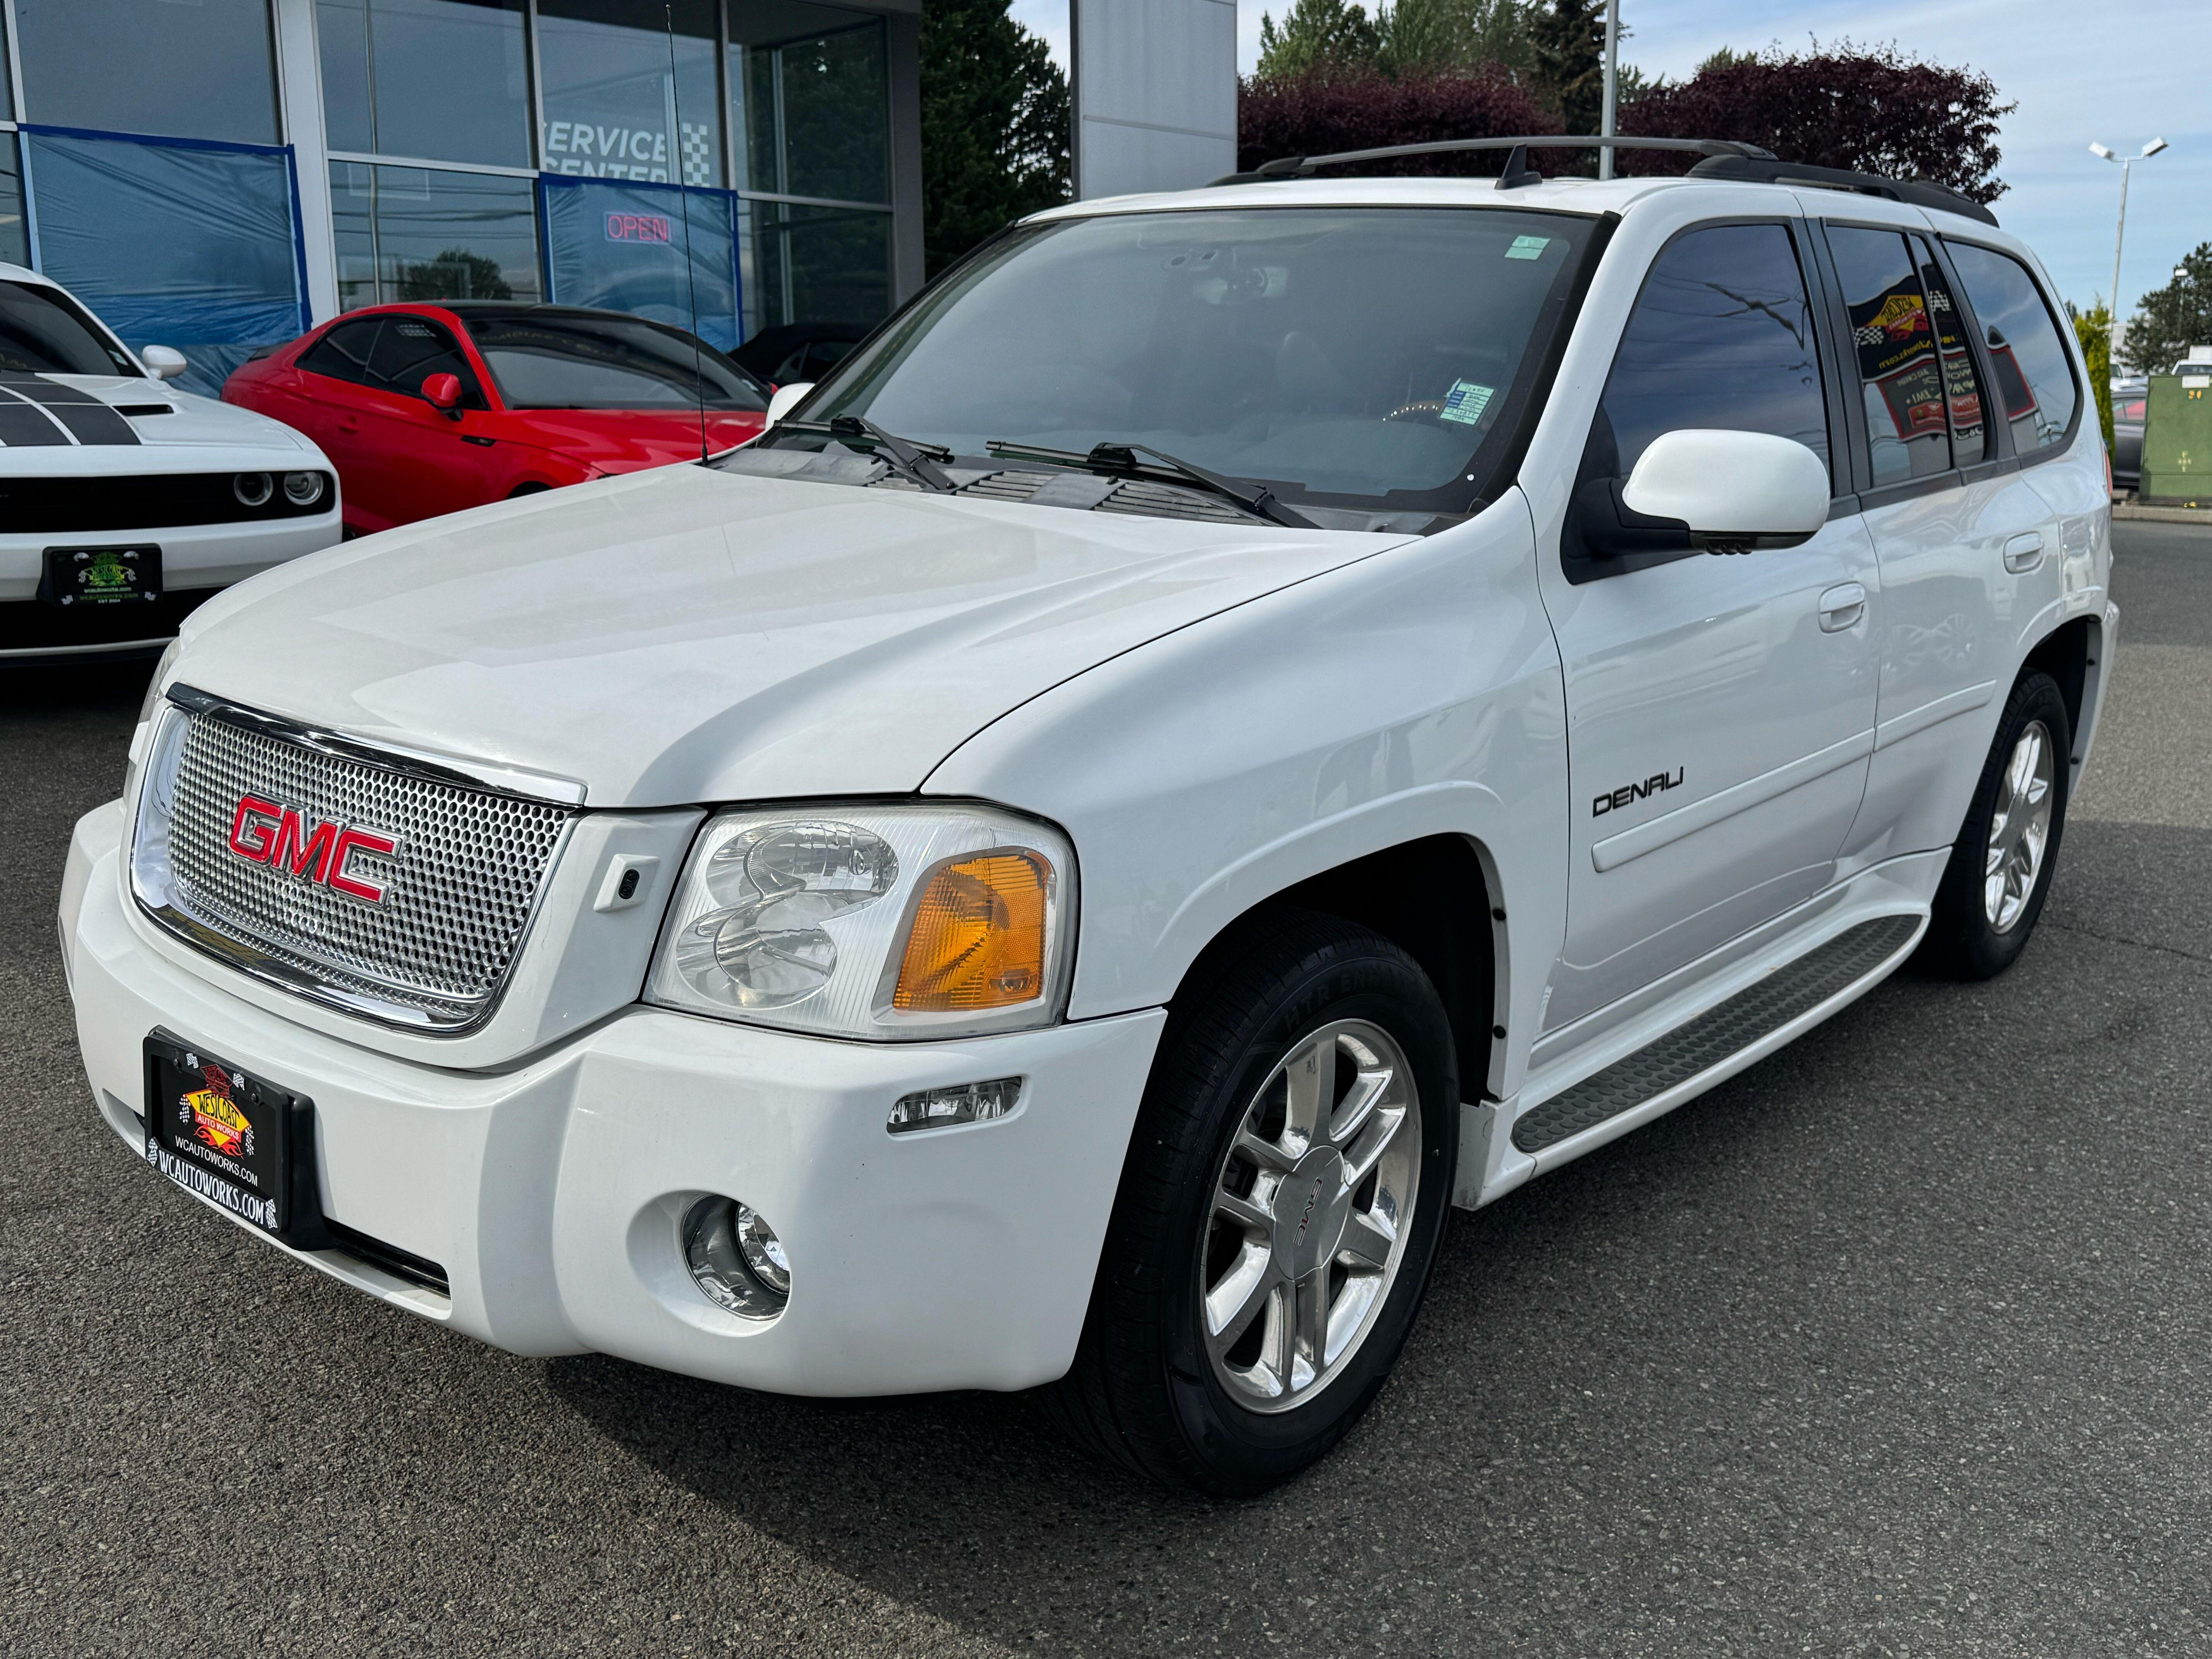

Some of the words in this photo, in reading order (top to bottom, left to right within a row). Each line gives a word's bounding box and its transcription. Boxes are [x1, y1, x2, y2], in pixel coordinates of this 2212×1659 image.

[543, 121, 666, 163] ERVICE
[608, 215, 668, 241] OPEN
[1593, 766, 1683, 817] DENALI
[230, 792, 406, 908] GMC
[198, 1114, 216, 1127] AUTO
[216, 1123, 239, 1140] WORKS
[175, 1135, 258, 1187] WCAUTOWORKS.COM
[158, 1150, 264, 1224] WCAUTOWORKS.COM
[1293, 1177, 1322, 1246] GMC
